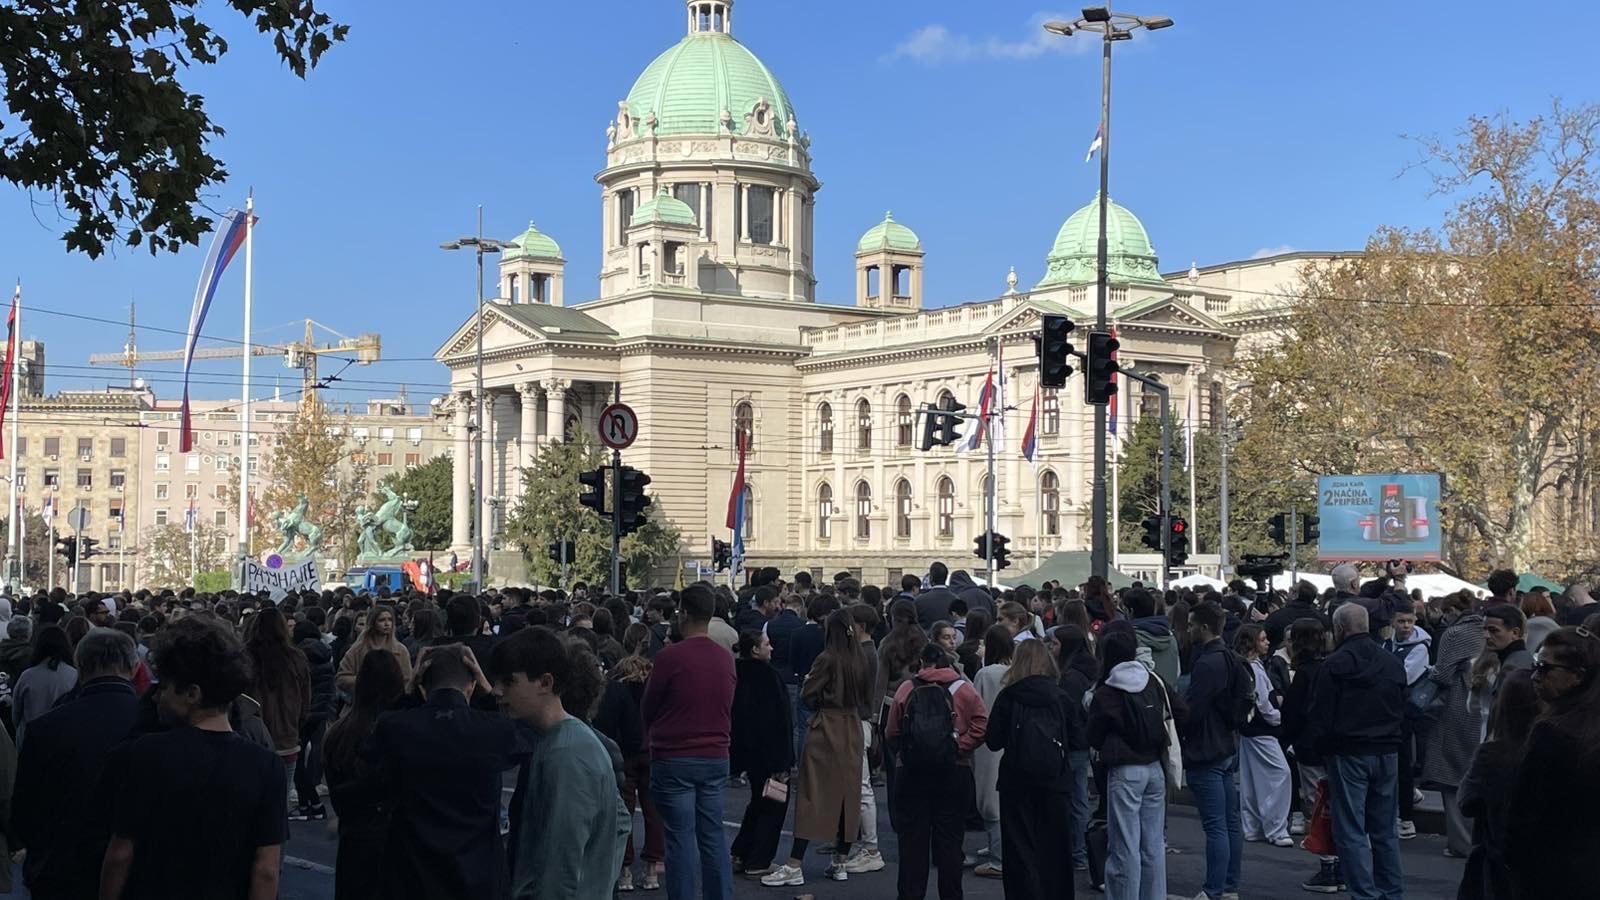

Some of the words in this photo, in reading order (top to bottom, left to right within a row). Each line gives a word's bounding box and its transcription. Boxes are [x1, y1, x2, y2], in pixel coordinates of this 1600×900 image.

[1323, 490, 1333, 506] 2
[1333, 488, 1367, 497] NAČINA
[1334, 497, 1374, 505] PRIPREME
